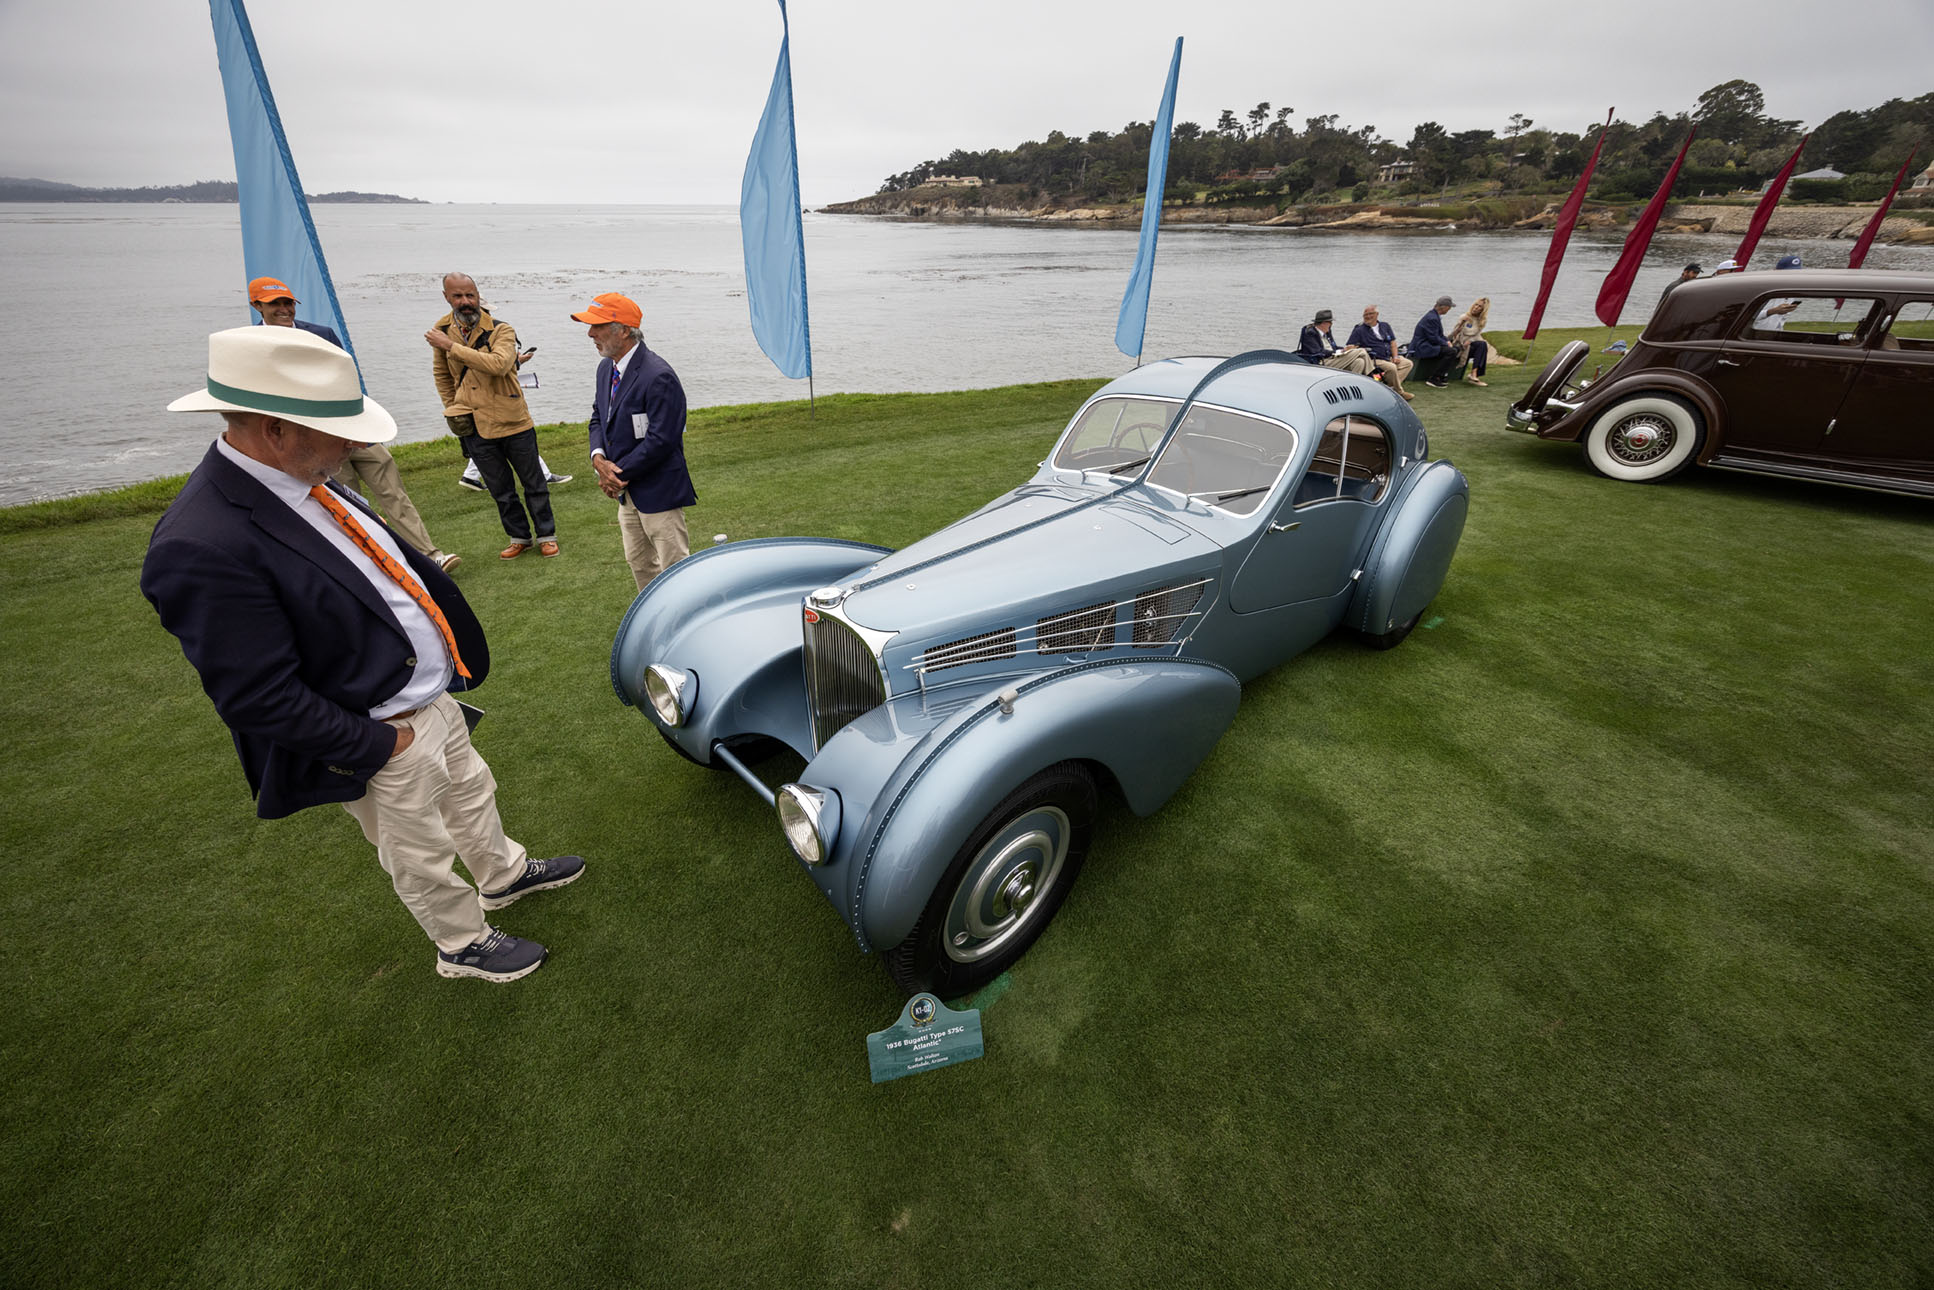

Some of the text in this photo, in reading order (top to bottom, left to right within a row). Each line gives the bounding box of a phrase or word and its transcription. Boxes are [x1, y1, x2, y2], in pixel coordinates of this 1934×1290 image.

[903, 1034, 929, 1046] Bugatti
[929, 1031, 946, 1040] Type
[947, 1025, 965, 1035] 57SC
